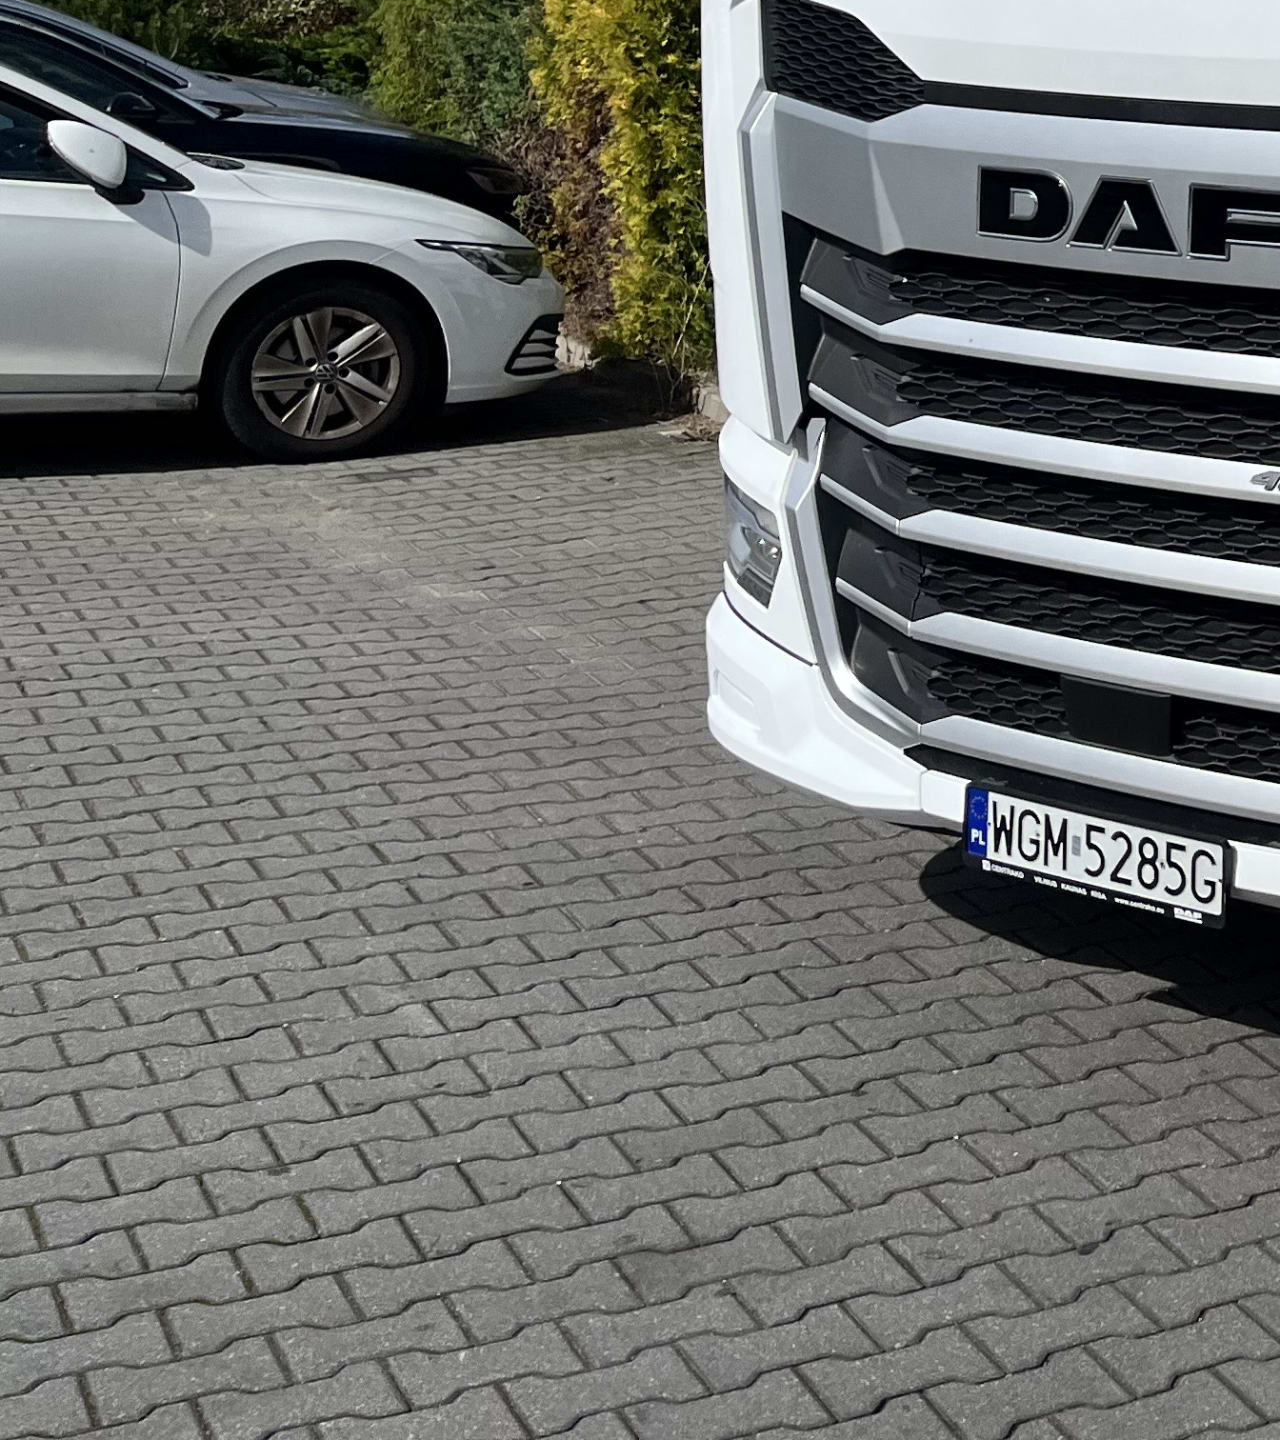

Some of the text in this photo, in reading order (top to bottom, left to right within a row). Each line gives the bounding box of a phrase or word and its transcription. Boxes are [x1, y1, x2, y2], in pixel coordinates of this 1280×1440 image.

[970, 828, 986, 846] PL
[991, 800, 1217, 904] WGM 5285G
